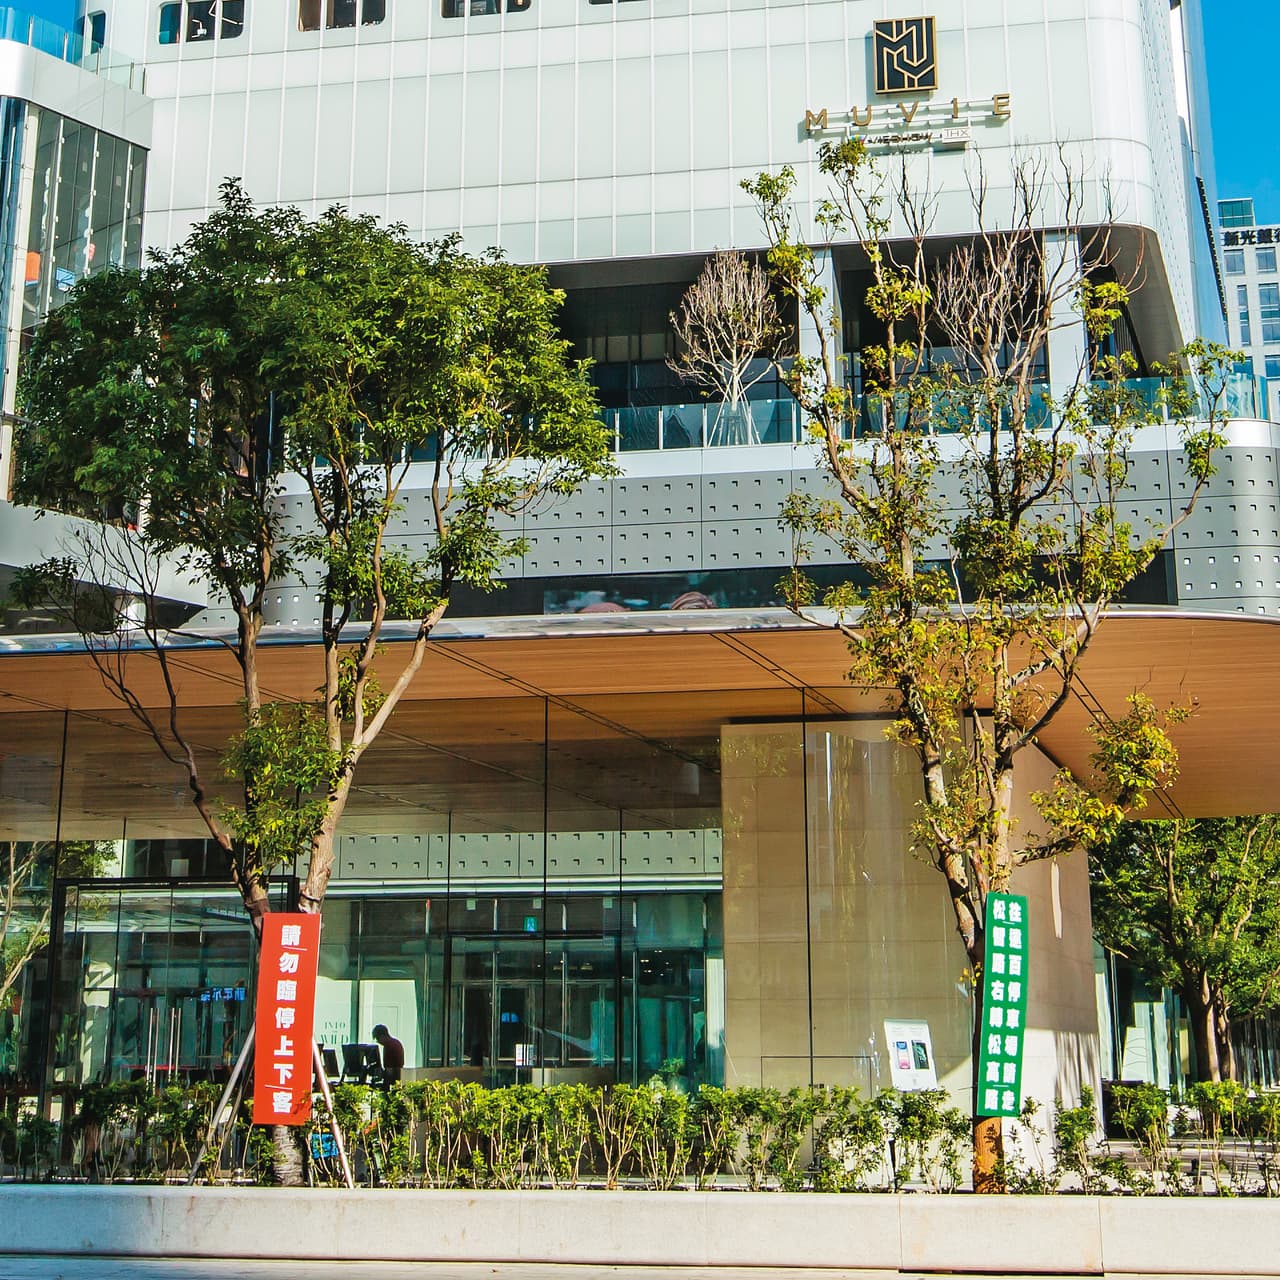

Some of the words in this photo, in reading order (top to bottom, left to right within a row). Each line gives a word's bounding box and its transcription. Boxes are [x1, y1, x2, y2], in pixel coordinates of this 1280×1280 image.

[805, 93, 1011, 131] MUVIE
[944, 128, 969, 138] THX
[273, 925, 301, 1113] 請勿臨停上下客
[985, 899, 1006, 1110] 松智路右轉松高路
[1002, 901, 1022, 1111] 往遠百停車場請走
